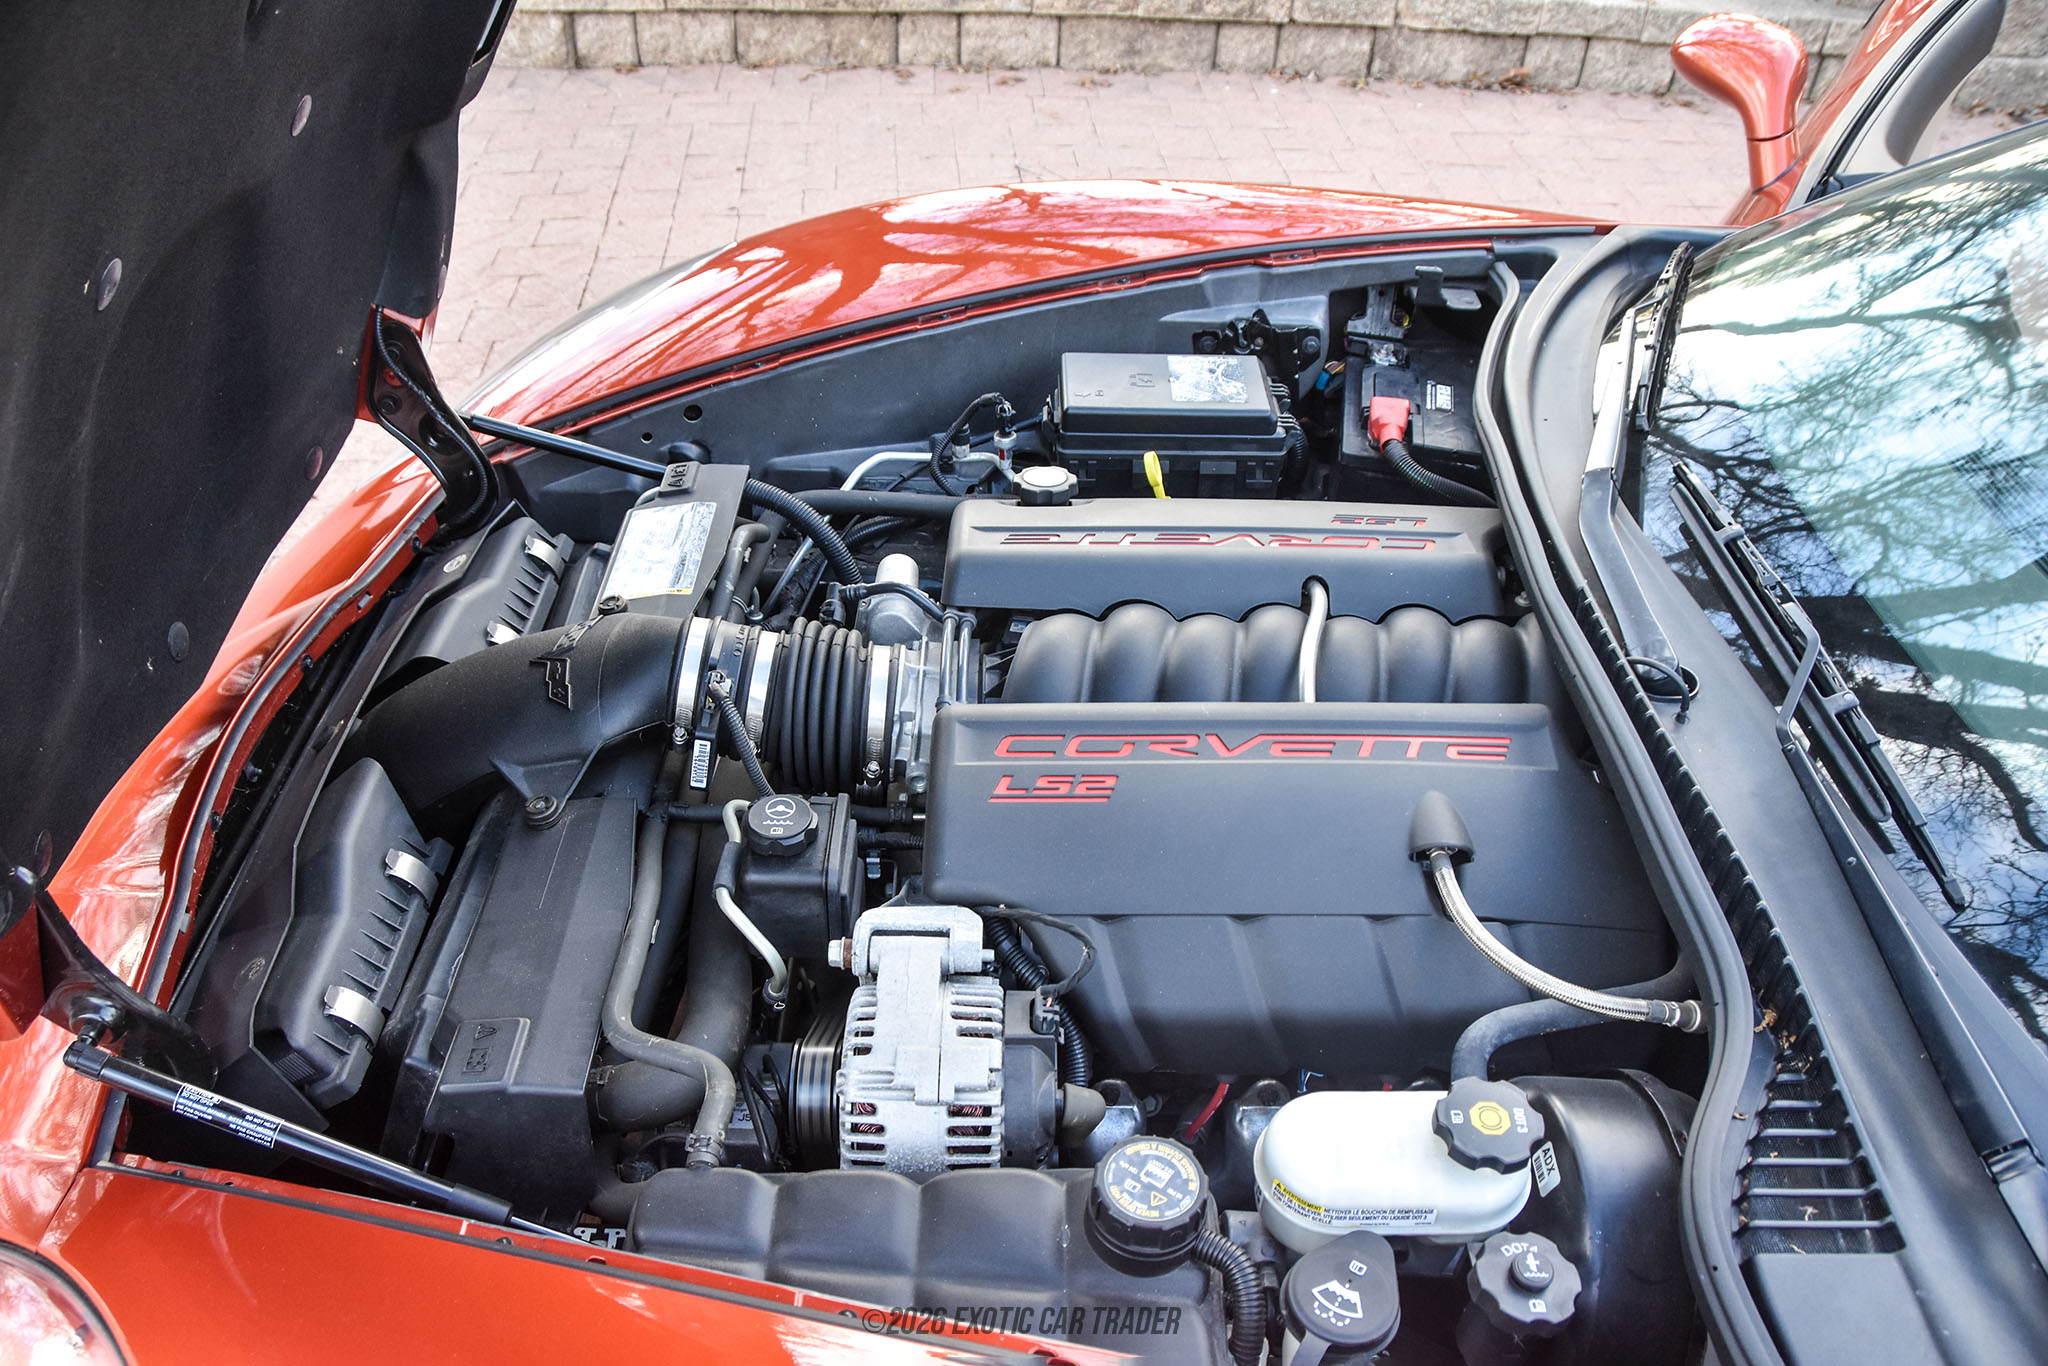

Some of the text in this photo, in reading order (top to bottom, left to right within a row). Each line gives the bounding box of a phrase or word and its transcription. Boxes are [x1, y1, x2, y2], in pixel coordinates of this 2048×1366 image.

[1000, 533, 1436, 551] CORVETTE
[994, 733, 1513, 761] CORVETTE
[994, 774, 1118, 796] LS2
[1542, 1148, 1555, 1176] ADX
[1283, 1187, 1322, 1212] AVERTISSEMENT
